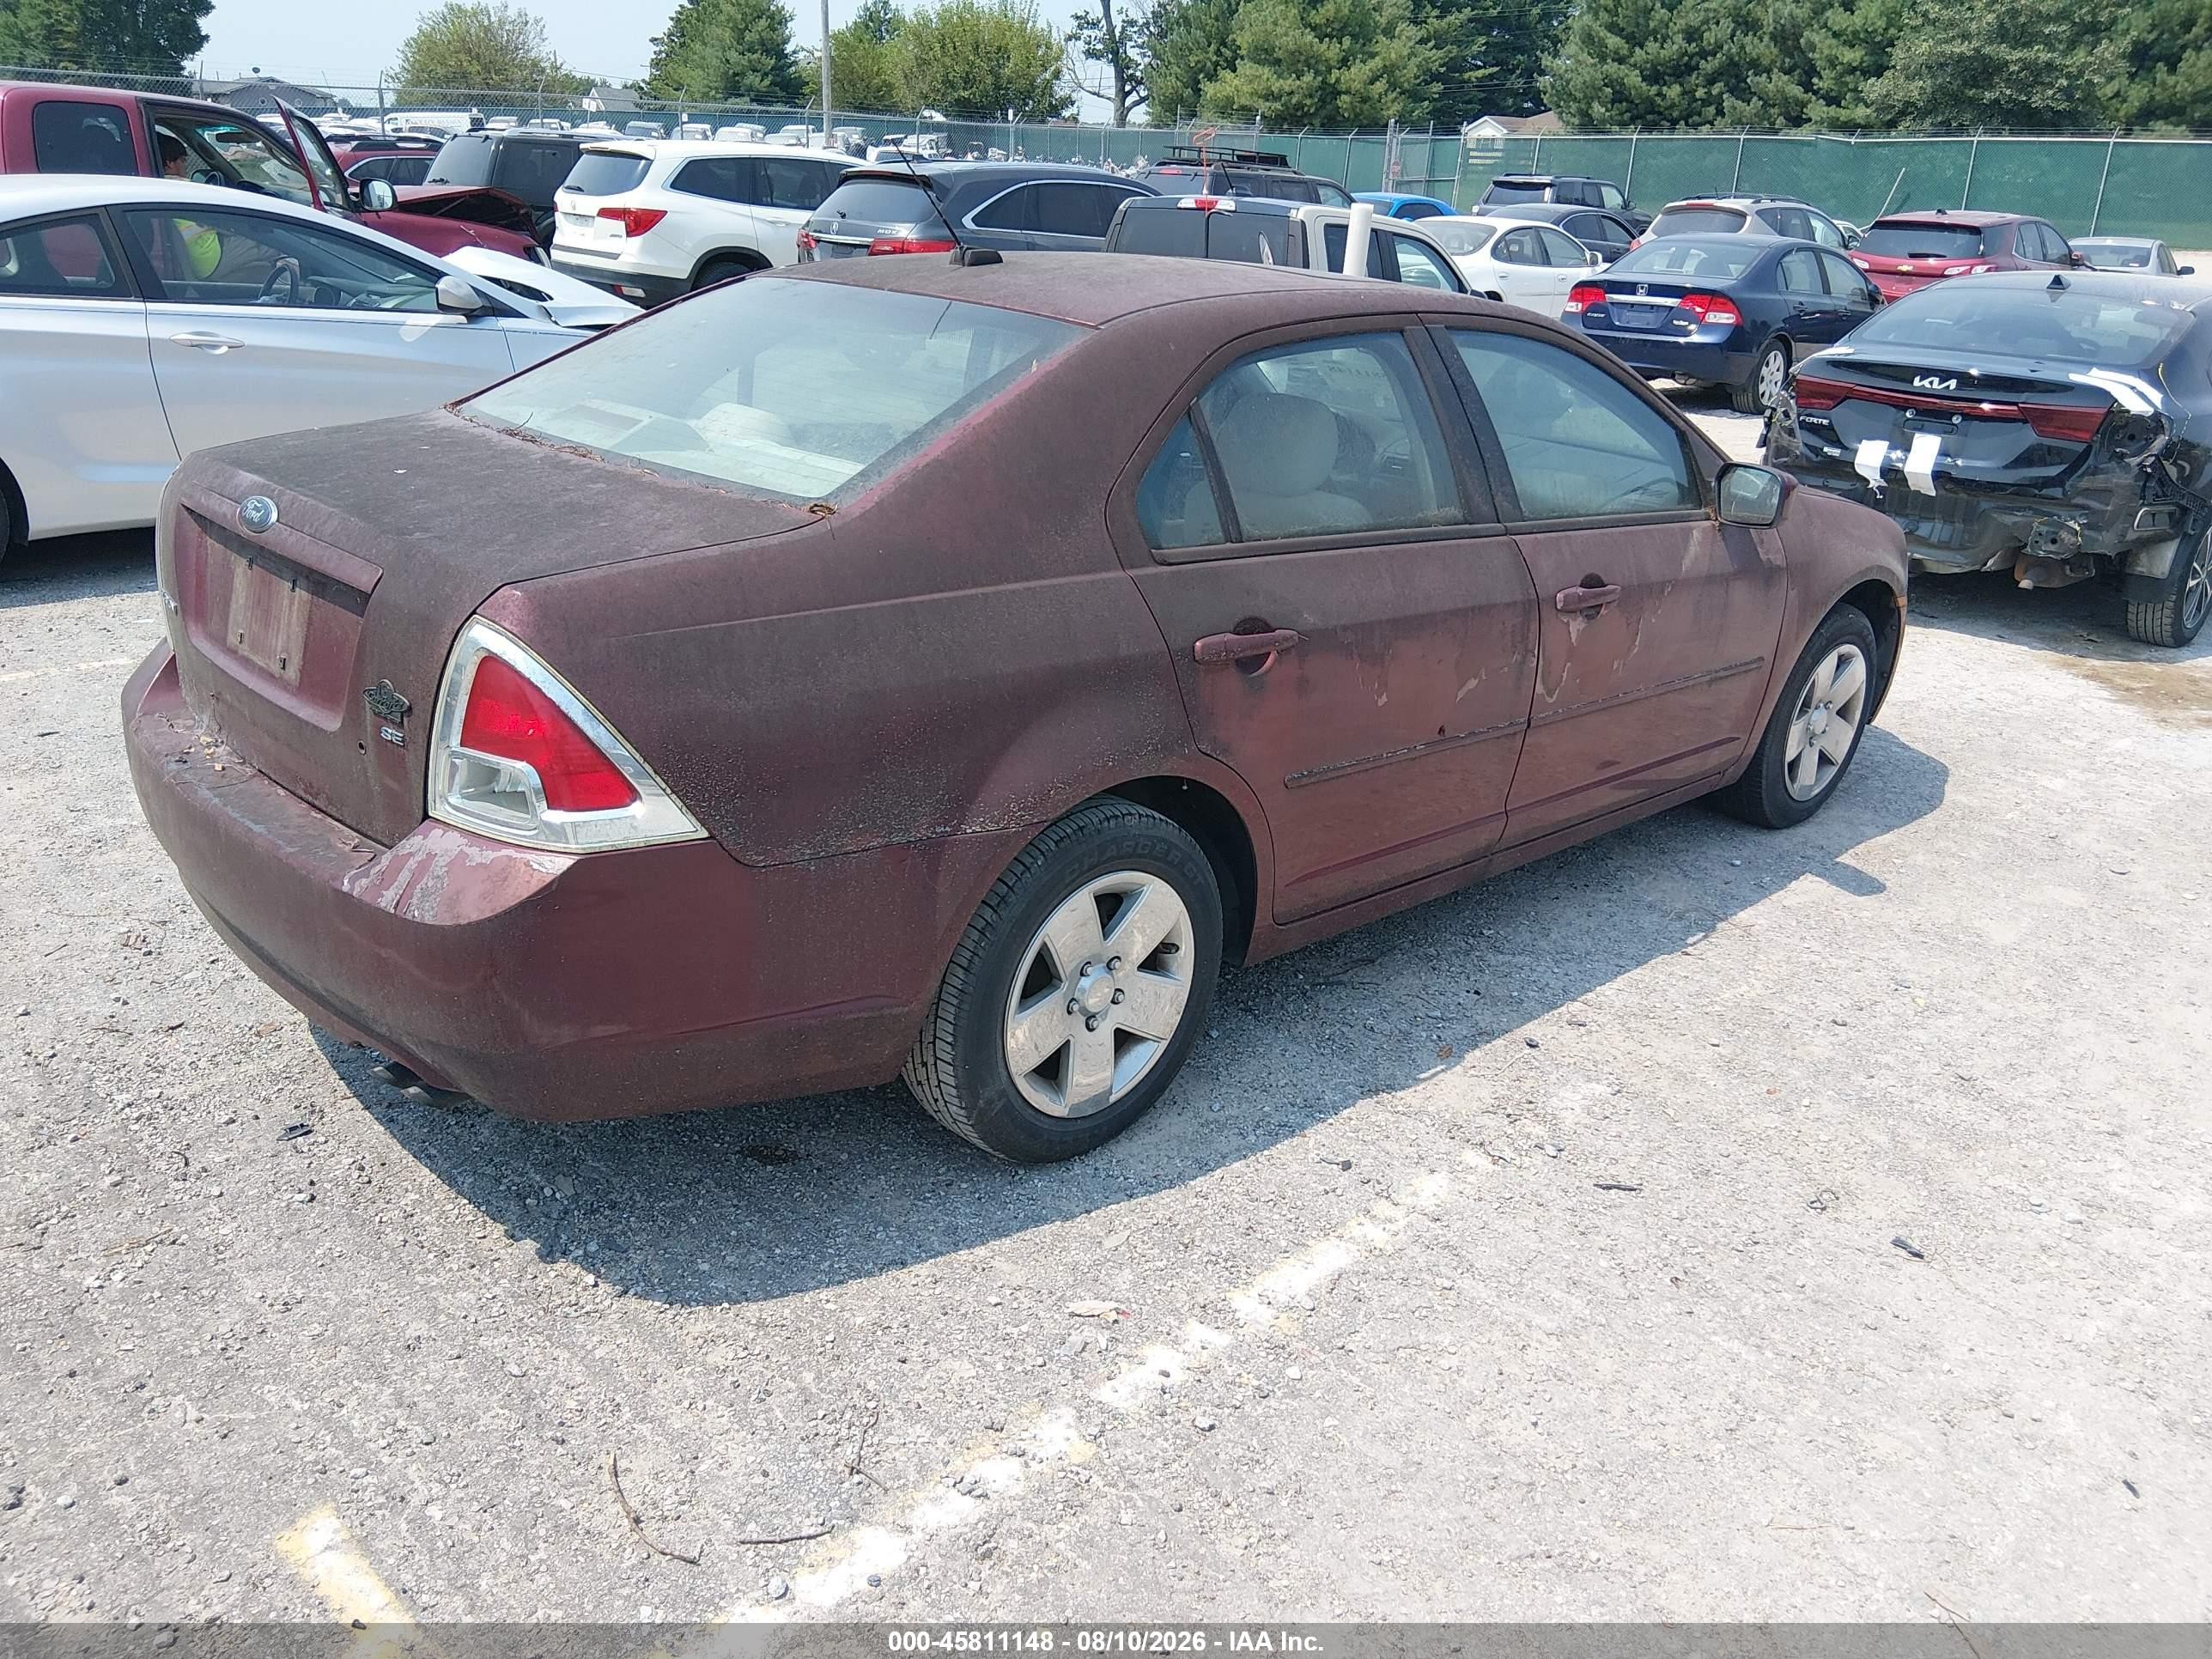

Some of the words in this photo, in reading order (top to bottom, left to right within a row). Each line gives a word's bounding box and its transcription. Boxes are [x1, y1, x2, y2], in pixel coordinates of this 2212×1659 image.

[1913, 375, 1958, 391] KIA
[1799, 416, 1831, 426] FORTE
[241, 499, 264, 522] Ford
[380, 726, 405, 746] SE
